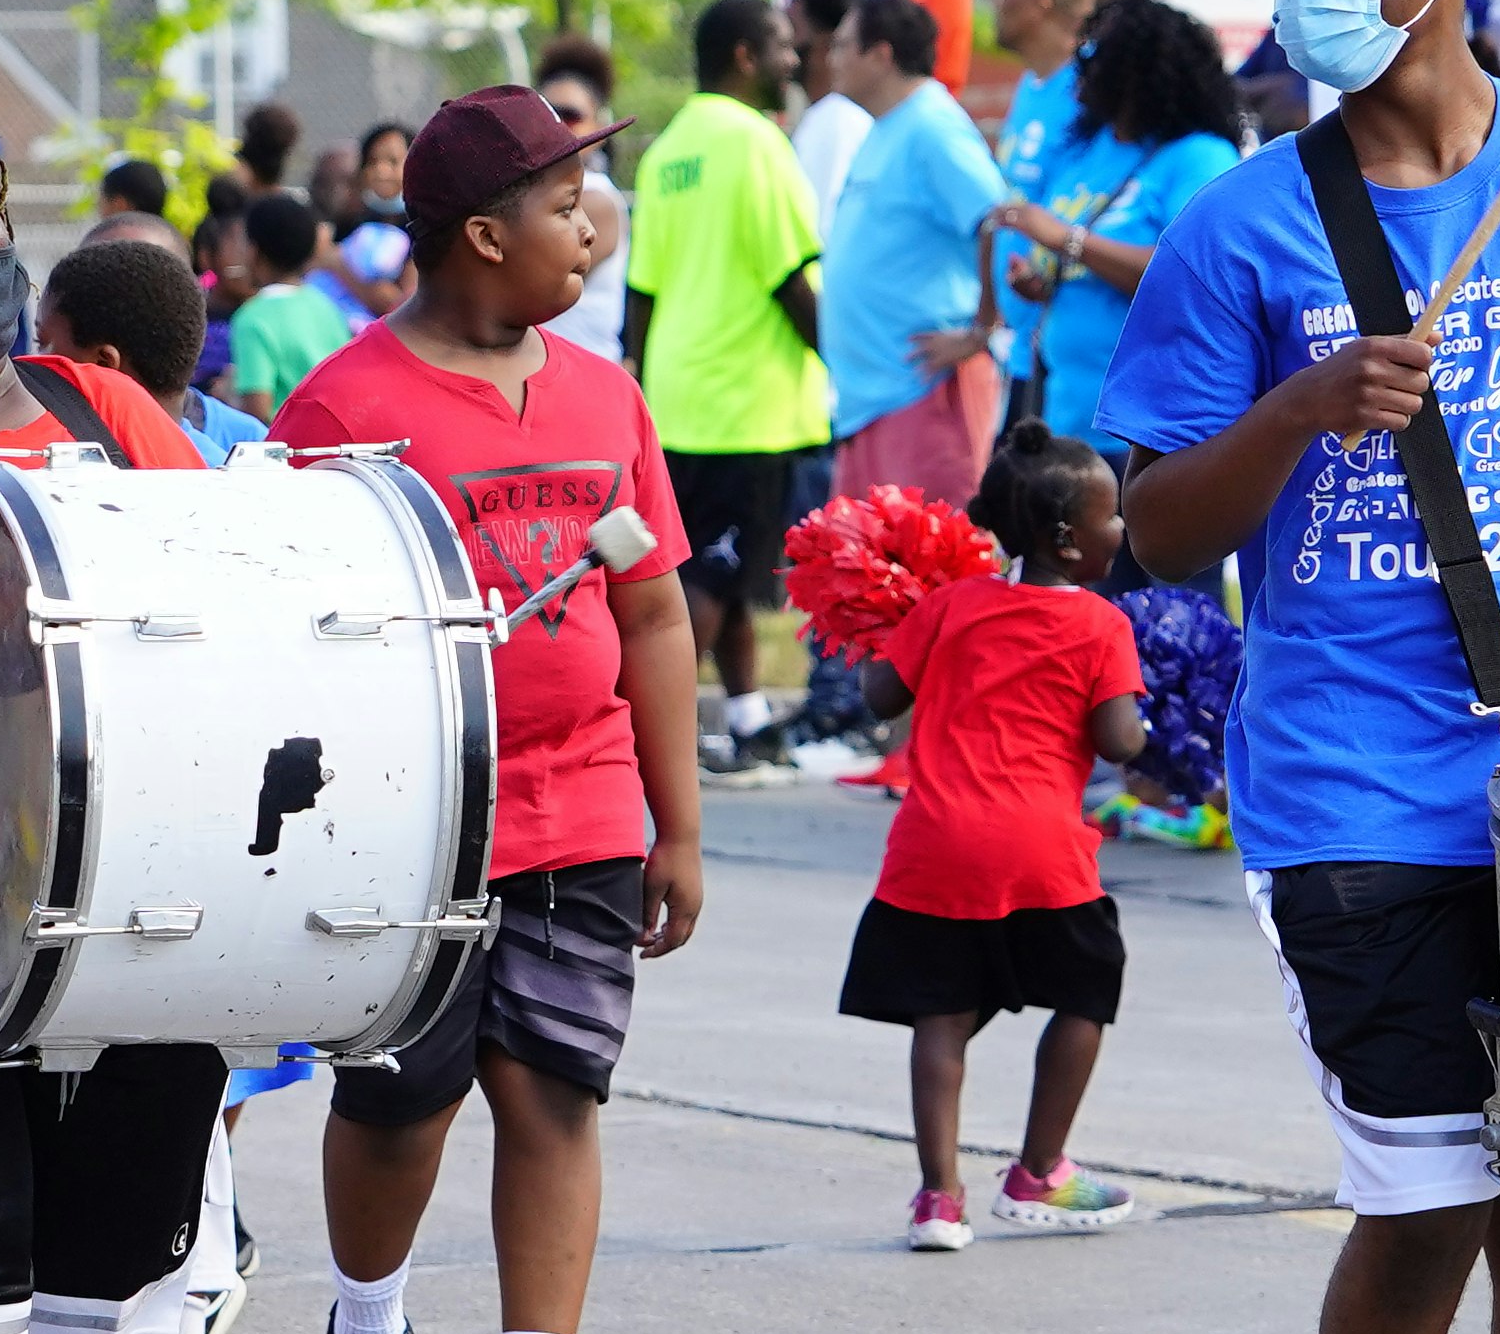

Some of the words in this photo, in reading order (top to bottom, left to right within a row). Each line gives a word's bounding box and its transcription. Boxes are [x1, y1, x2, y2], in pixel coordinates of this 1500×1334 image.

[1439, 335, 1483, 356] GOOD
[480, 480, 602, 514] GUESS
[1336, 532, 1440, 584] Tou
